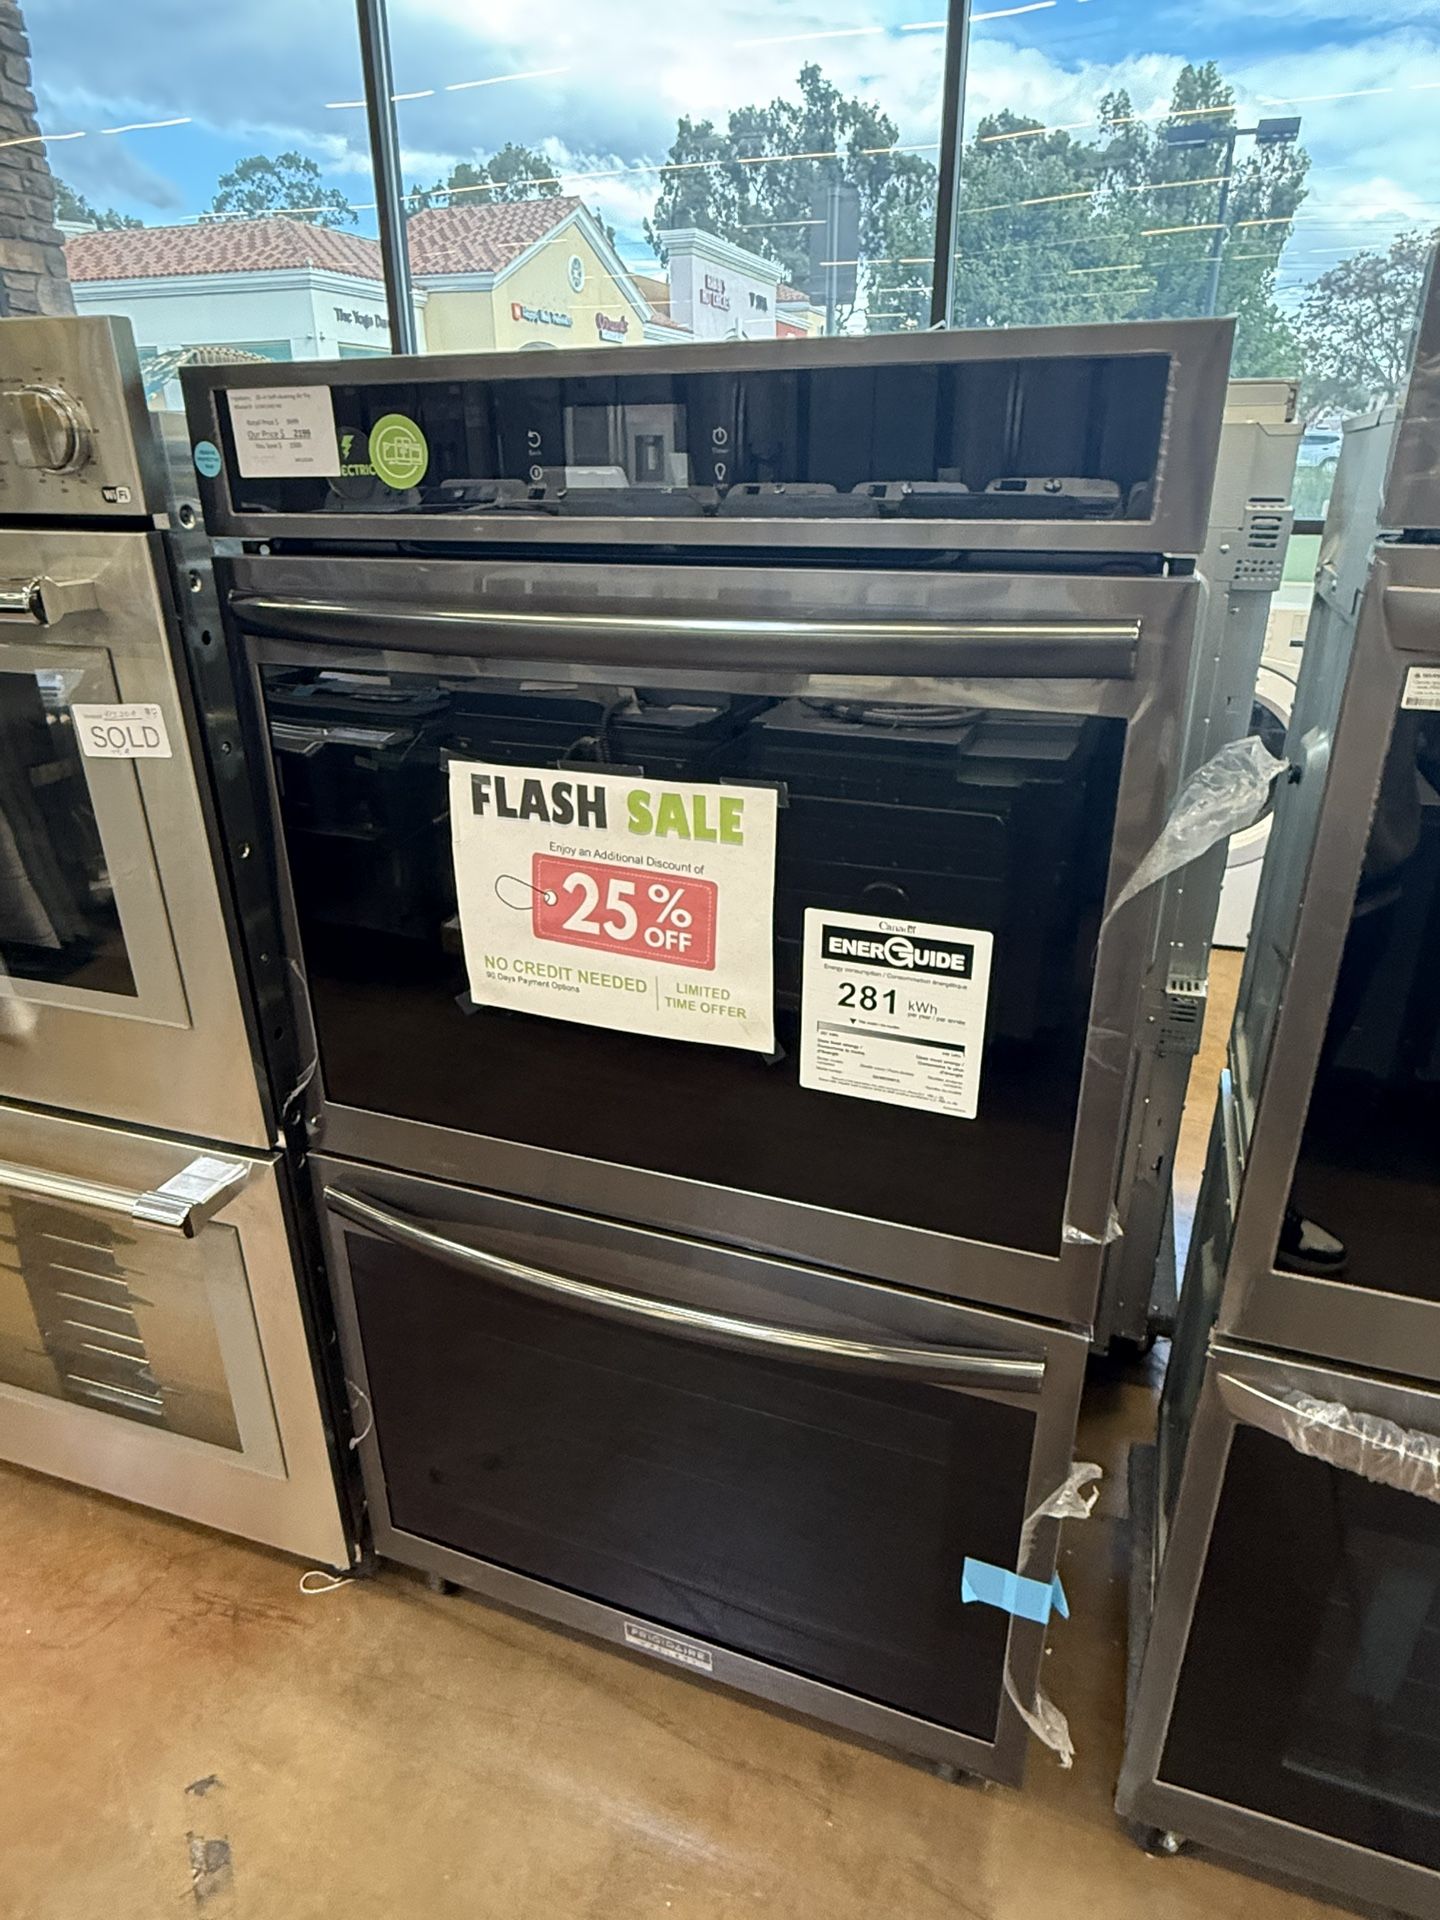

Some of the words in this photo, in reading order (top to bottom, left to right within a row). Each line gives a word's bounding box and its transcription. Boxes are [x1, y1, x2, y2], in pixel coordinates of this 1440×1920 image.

[333, 307, 352, 323] The
[246, 430, 260, 438] Our
[261, 430, 279, 438] Price
[279, 428, 285, 438] $
[340, 464, 377, 477] ECTRIC
[91, 726, 160, 748] SOLD
[470, 773, 608, 829] FLASH
[626, 789, 745, 846] SALE
[549, 841, 577, 856] Enjoy
[579, 847, 592, 857] an
[593, 849, 644, 865] Additional
[647, 856, 691, 873] Discount
[694, 864, 705, 875] of
[644, 926, 692, 952] OFF
[828, 936, 966, 972] ENERGUIDE
[484, 955, 508, 972] NO
[513, 958, 573, 983] CREDIT
[577, 968, 647, 993] NEEDED
[824, 963, 842, 972] Energy
[497, 972, 516, 984] Days
[518, 975, 550, 988] Payment
[551, 981, 581, 993] Options
[675, 982, 730, 1001] LIMITED
[664, 996, 697, 1012] TIME
[700, 999, 747, 1019] OFFER
[837, 980, 896, 1014] 281
[907, 999, 938, 1015] kWh
